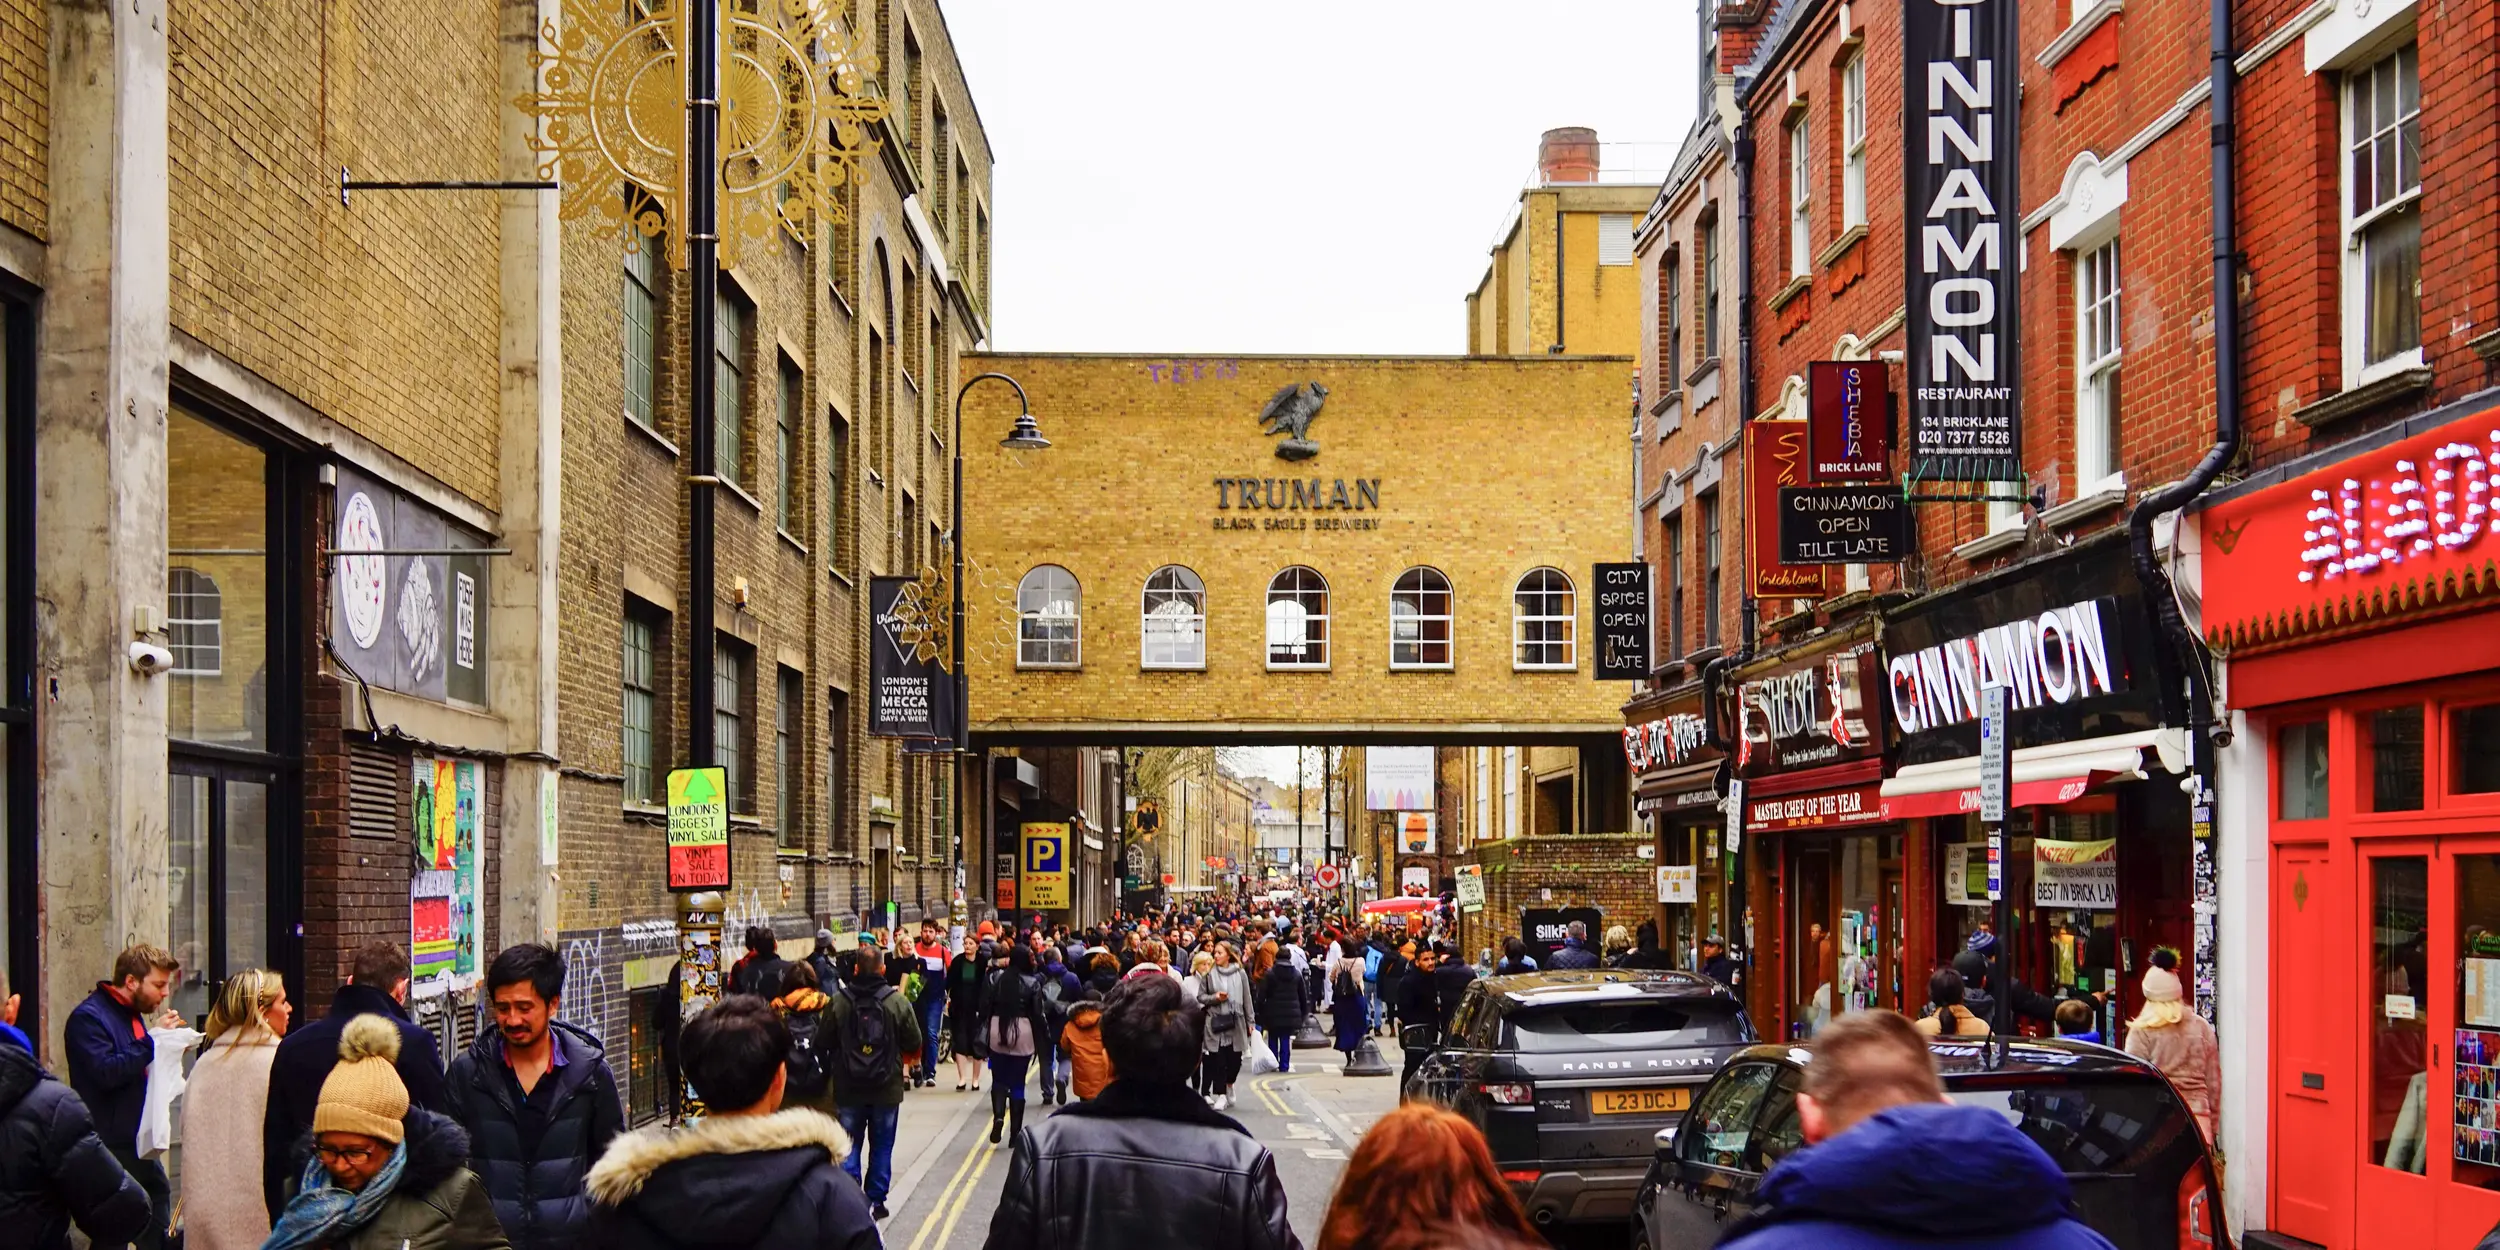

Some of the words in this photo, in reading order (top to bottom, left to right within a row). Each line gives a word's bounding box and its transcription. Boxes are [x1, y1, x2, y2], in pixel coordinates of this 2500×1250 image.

[1922, 0, 2000, 382] INNAMON
[1918, 388, 2012, 400] RESTAURANT
[1921, 417, 1939, 427] 134
[1943, 416, 2009, 427] BRICKLANE
[1918, 431, 1941, 444] 020
[1946, 431, 1974, 444] 7377
[1980, 431, 2010, 444] 5526
[1819, 462, 1851, 473] BRICK
[1854, 462, 1882, 473] LANE
[1213, 478, 1381, 510] TRUMAN
[1793, 494, 1894, 512] CINNAMON
[1212, 517, 1257, 531] BLACK
[1264, 517, 1306, 531] EAGLE
[1314, 517, 1381, 531] BREWERY
[1819, 517, 1870, 534] OPEN
[1847, 538, 1889, 556] LATE
[1606, 569, 1641, 584] CITY
[1601, 592, 1645, 606] SPICE
[1603, 613, 1645, 626] OPEN
[1605, 655, 1643, 668] LATE
[1889, 600, 2113, 734] CINNAMON
[881, 676, 928, 685] LONDON'S
[882, 686, 928, 695] VINTAGE
[881, 696, 928, 707] MECCA
[904, 708, 928, 716] SEVEN
[1759, 667, 1816, 765] SHEBA
[1984, 719, 1989, 736] P
[669, 803, 719, 817] LONDONS
[1754, 802, 1784, 821] MASTER
[1784, 799, 1805, 819] CHEF
[1806, 798, 1818, 817] OF
[1819, 795, 1836, 816] THE
[1837, 792, 1861, 813] YEAR
[668, 817, 715, 829] BIGGEST
[669, 831, 698, 843] VINYL
[701, 829, 726, 841] SALE
[685, 848, 715, 860] VINYL
[1033, 840, 1055, 870] P
[689, 859, 715, 871] SALE
[670, 873, 686, 884] ON
[689, 872, 725, 884] TODAY
[2037, 883, 2058, 901] BEST
[2060, 883, 2069, 901] IN
[2069, 884, 2096, 902] BRICK
[2098, 884, 2117, 902] LAN
[688, 912, 704, 922] AV
[1563, 1061, 1632, 1071] RANGE
[1648, 1058, 1714, 1067] ROVER
[1605, 1093, 1638, 1111] L23
[1644, 1092, 1677, 1109] DCJ
